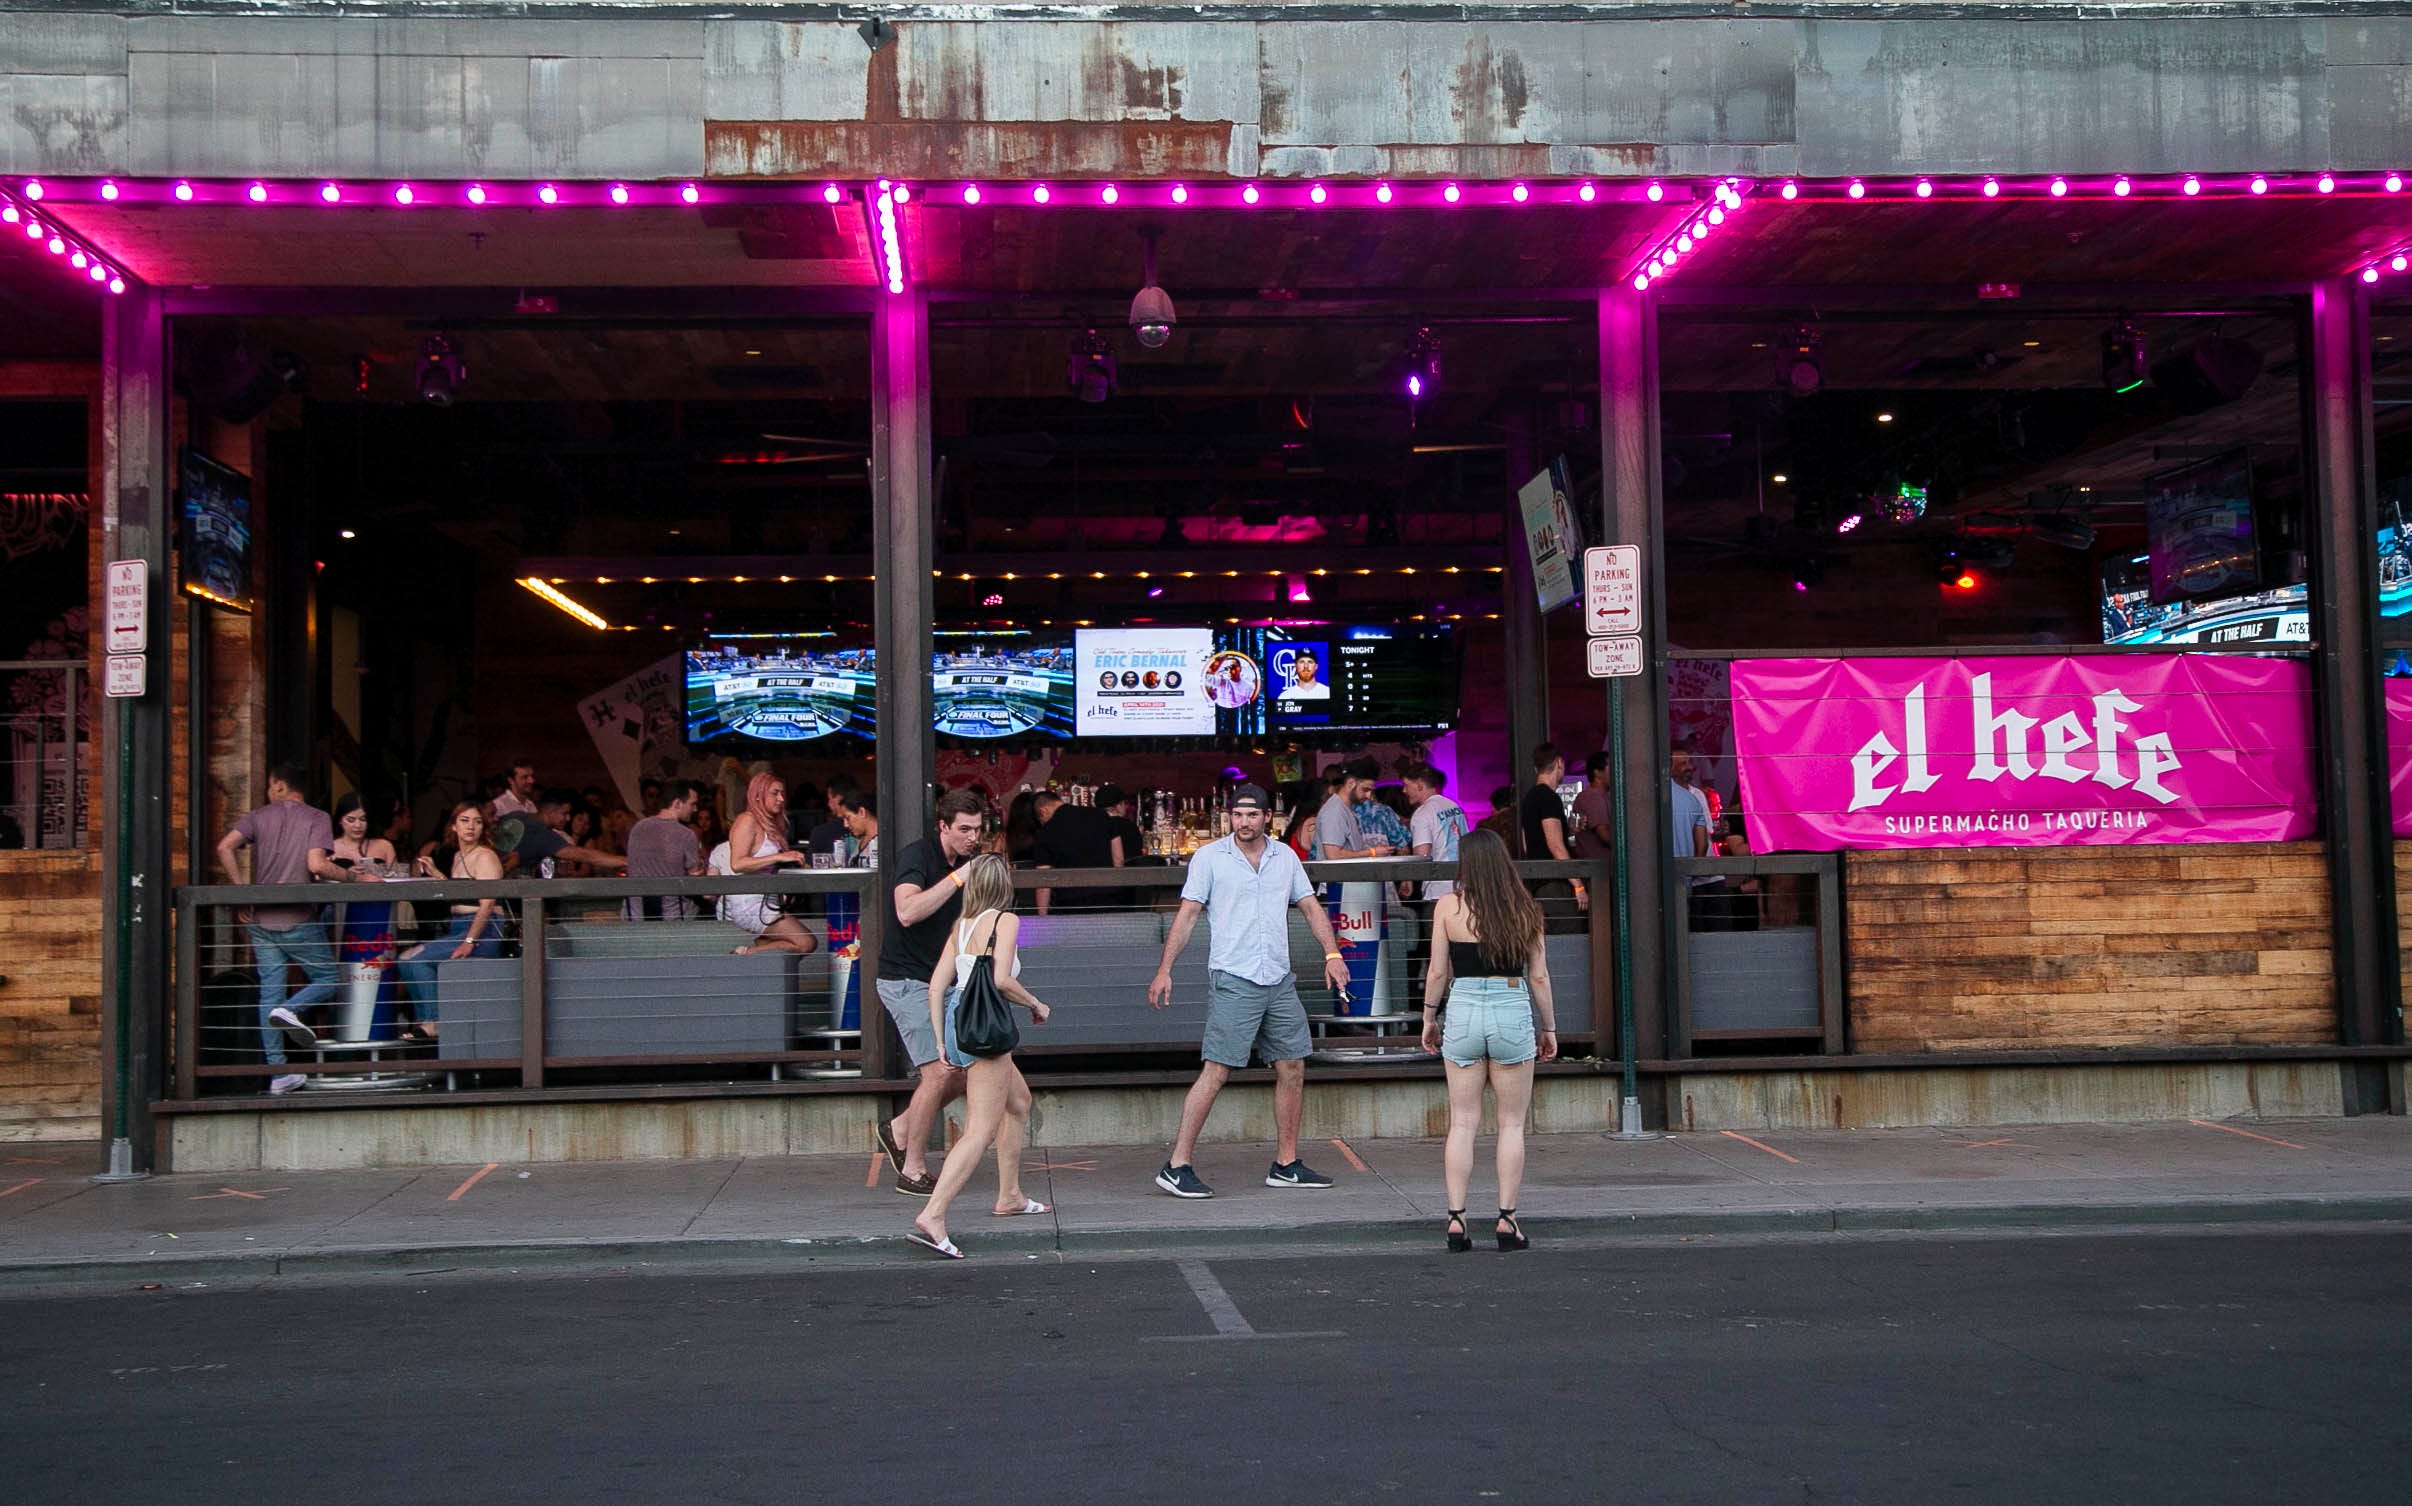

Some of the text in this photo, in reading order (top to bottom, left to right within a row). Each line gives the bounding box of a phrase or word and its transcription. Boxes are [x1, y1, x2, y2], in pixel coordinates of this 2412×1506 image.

[1606, 554, 1617, 566] NO
[1594, 568, 1630, 581] PARKING
[1593, 584, 1611, 593] THURS
[1621, 583, 1633, 592] SUN
[1625, 594, 1633, 602] AM
[2211, 623, 2264, 643] AT THE HALF
[1340, 646, 1375, 654] TONIGHT
[1594, 642, 1634, 652] TOW-AWAY
[1095, 654, 1188, 668] ERIC BERNAL
[1606, 654, 1624, 663] ZONE
[763, 713, 789, 722] FINAL
[957, 710, 1009, 719] FINAL FOUR
[1847, 671, 2181, 812] el hefe
[1884, 810, 2148, 834] SUPERMACHO TAQUERIA
[1336, 911, 1372, 931] Bull
